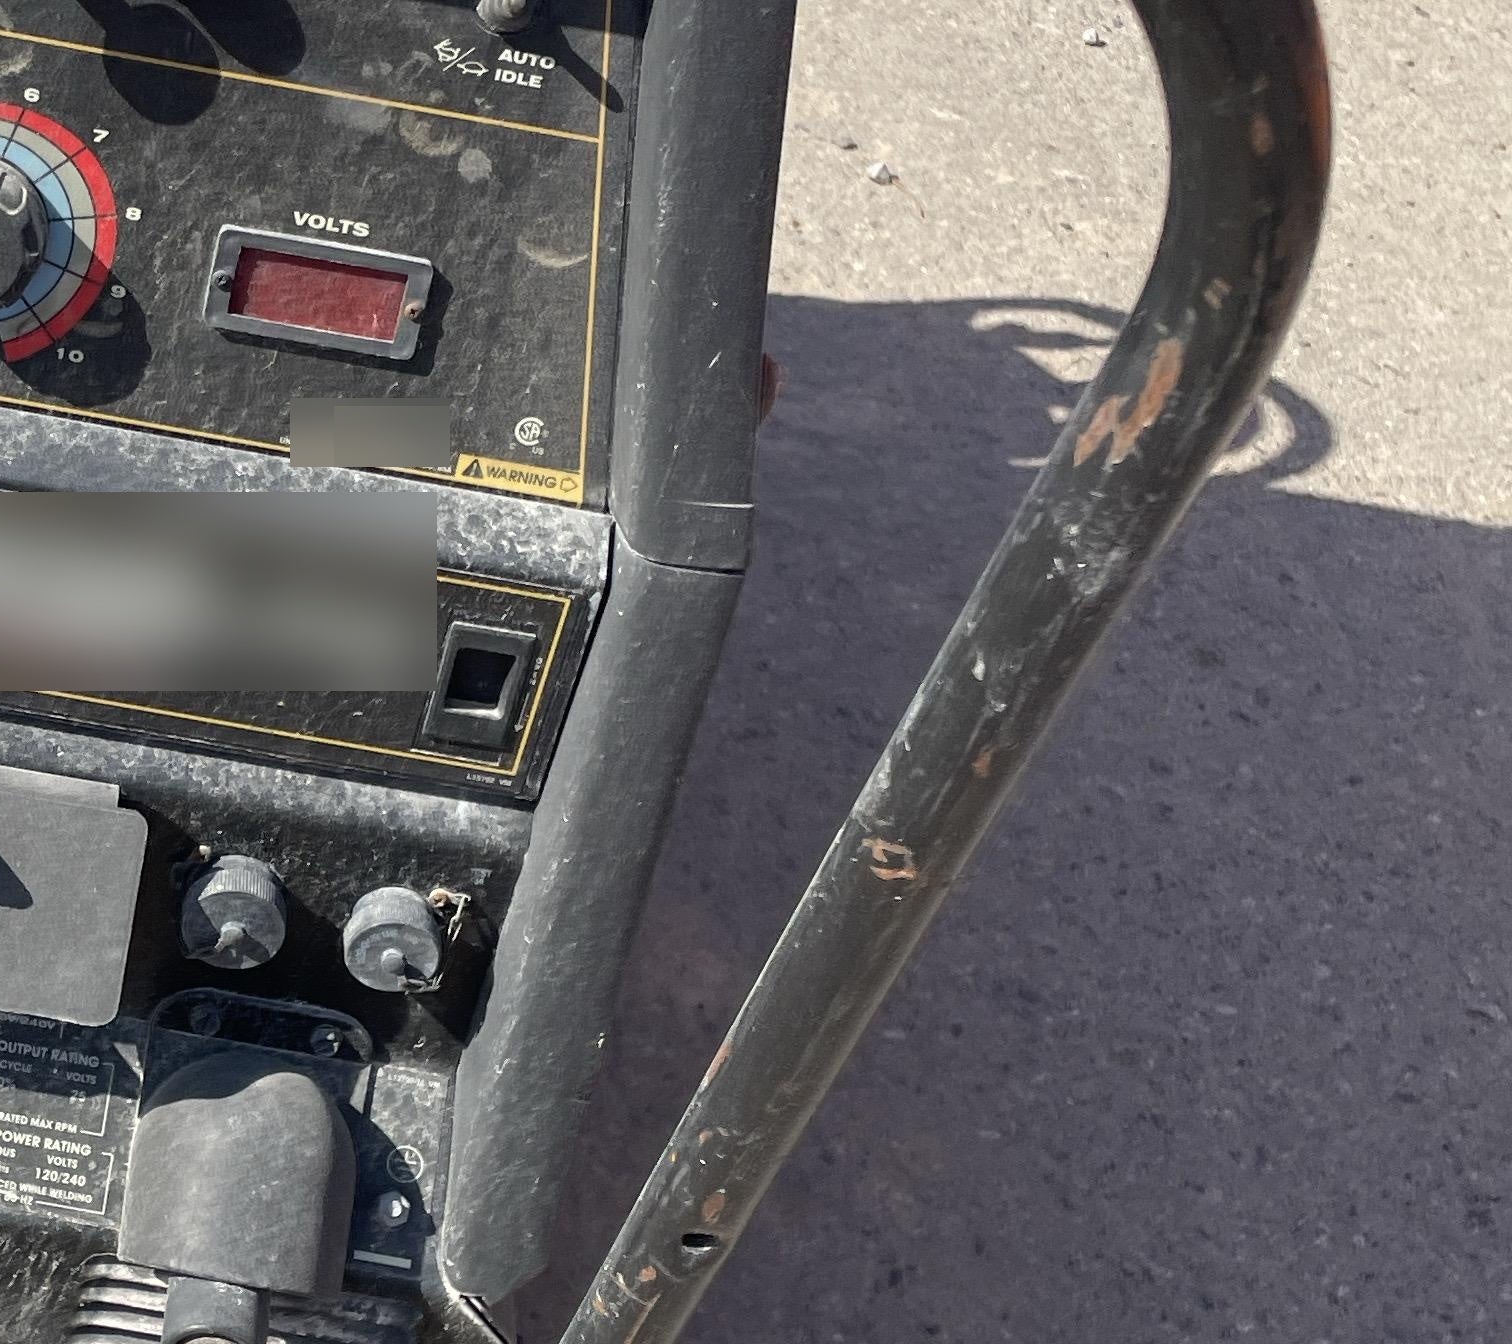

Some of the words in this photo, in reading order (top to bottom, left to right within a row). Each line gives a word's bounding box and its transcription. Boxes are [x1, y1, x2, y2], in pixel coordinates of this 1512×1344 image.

[497, 47, 556, 71] AUTO
[494, 67, 543, 90] IDLE
[24, 88, 40, 103] 6
[93, 129, 110, 143] 7
[124, 207, 142, 222] 8
[292, 211, 370, 238] VOLTS
[110, 284, 127, 299] 9
[56, 348, 84, 364] 10
[486, 464, 557, 489] WARNING
[50, 1049, 100, 1068] RATING
[0, 1060, 33, 1073] CYCLE
[66, 1071, 97, 1085] VOLTS
[30, 1117, 54, 1130] MAX
[54, 1122, 78, 1134] RPM
[44, 1138, 92, 1156] RATING
[47, 1155, 78, 1169] VOLTS
[35, 1167, 87, 1187] 120/240
[19, 1182, 48, 1196] WHILE
[49, 1189, 93, 1204] WELDING
